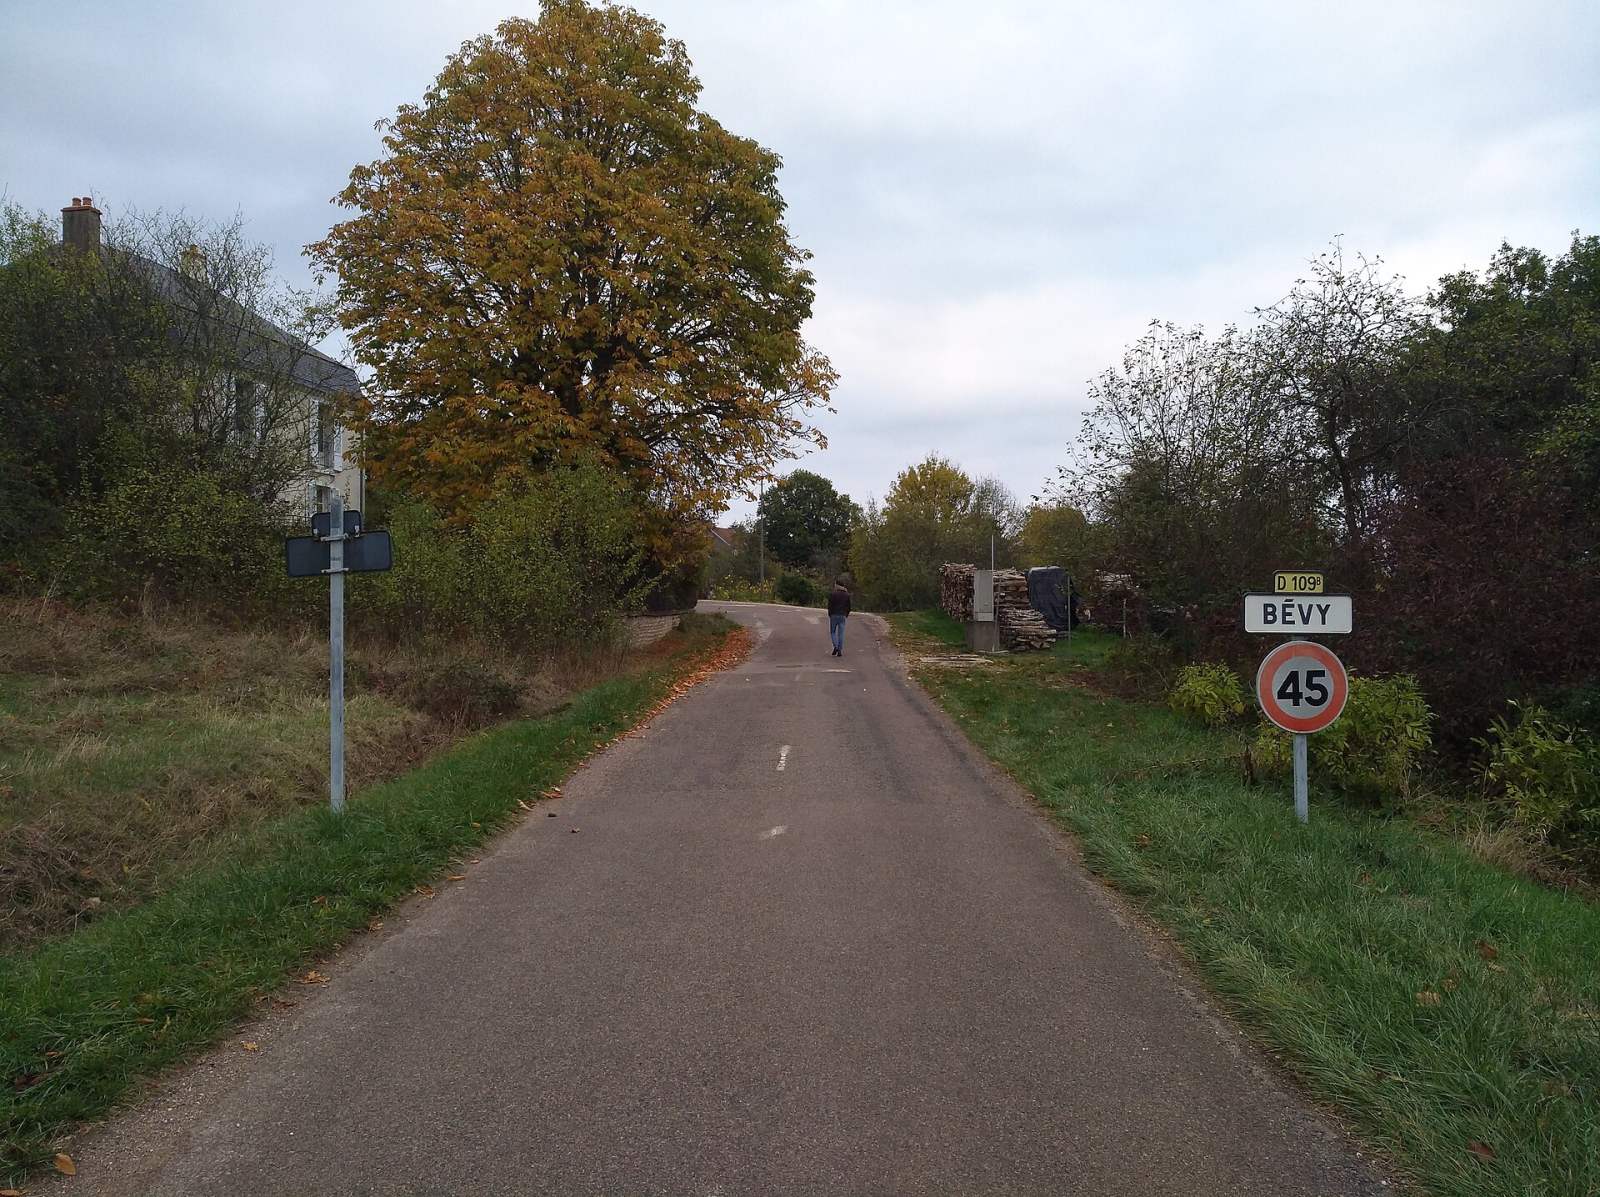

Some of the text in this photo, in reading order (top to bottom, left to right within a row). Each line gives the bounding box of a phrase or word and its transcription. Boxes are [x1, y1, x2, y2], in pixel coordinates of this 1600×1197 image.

[1278, 576, 1286, 590] D
[1263, 599, 1331, 625] BÉVY
[1277, 670, 1329, 707] 45
